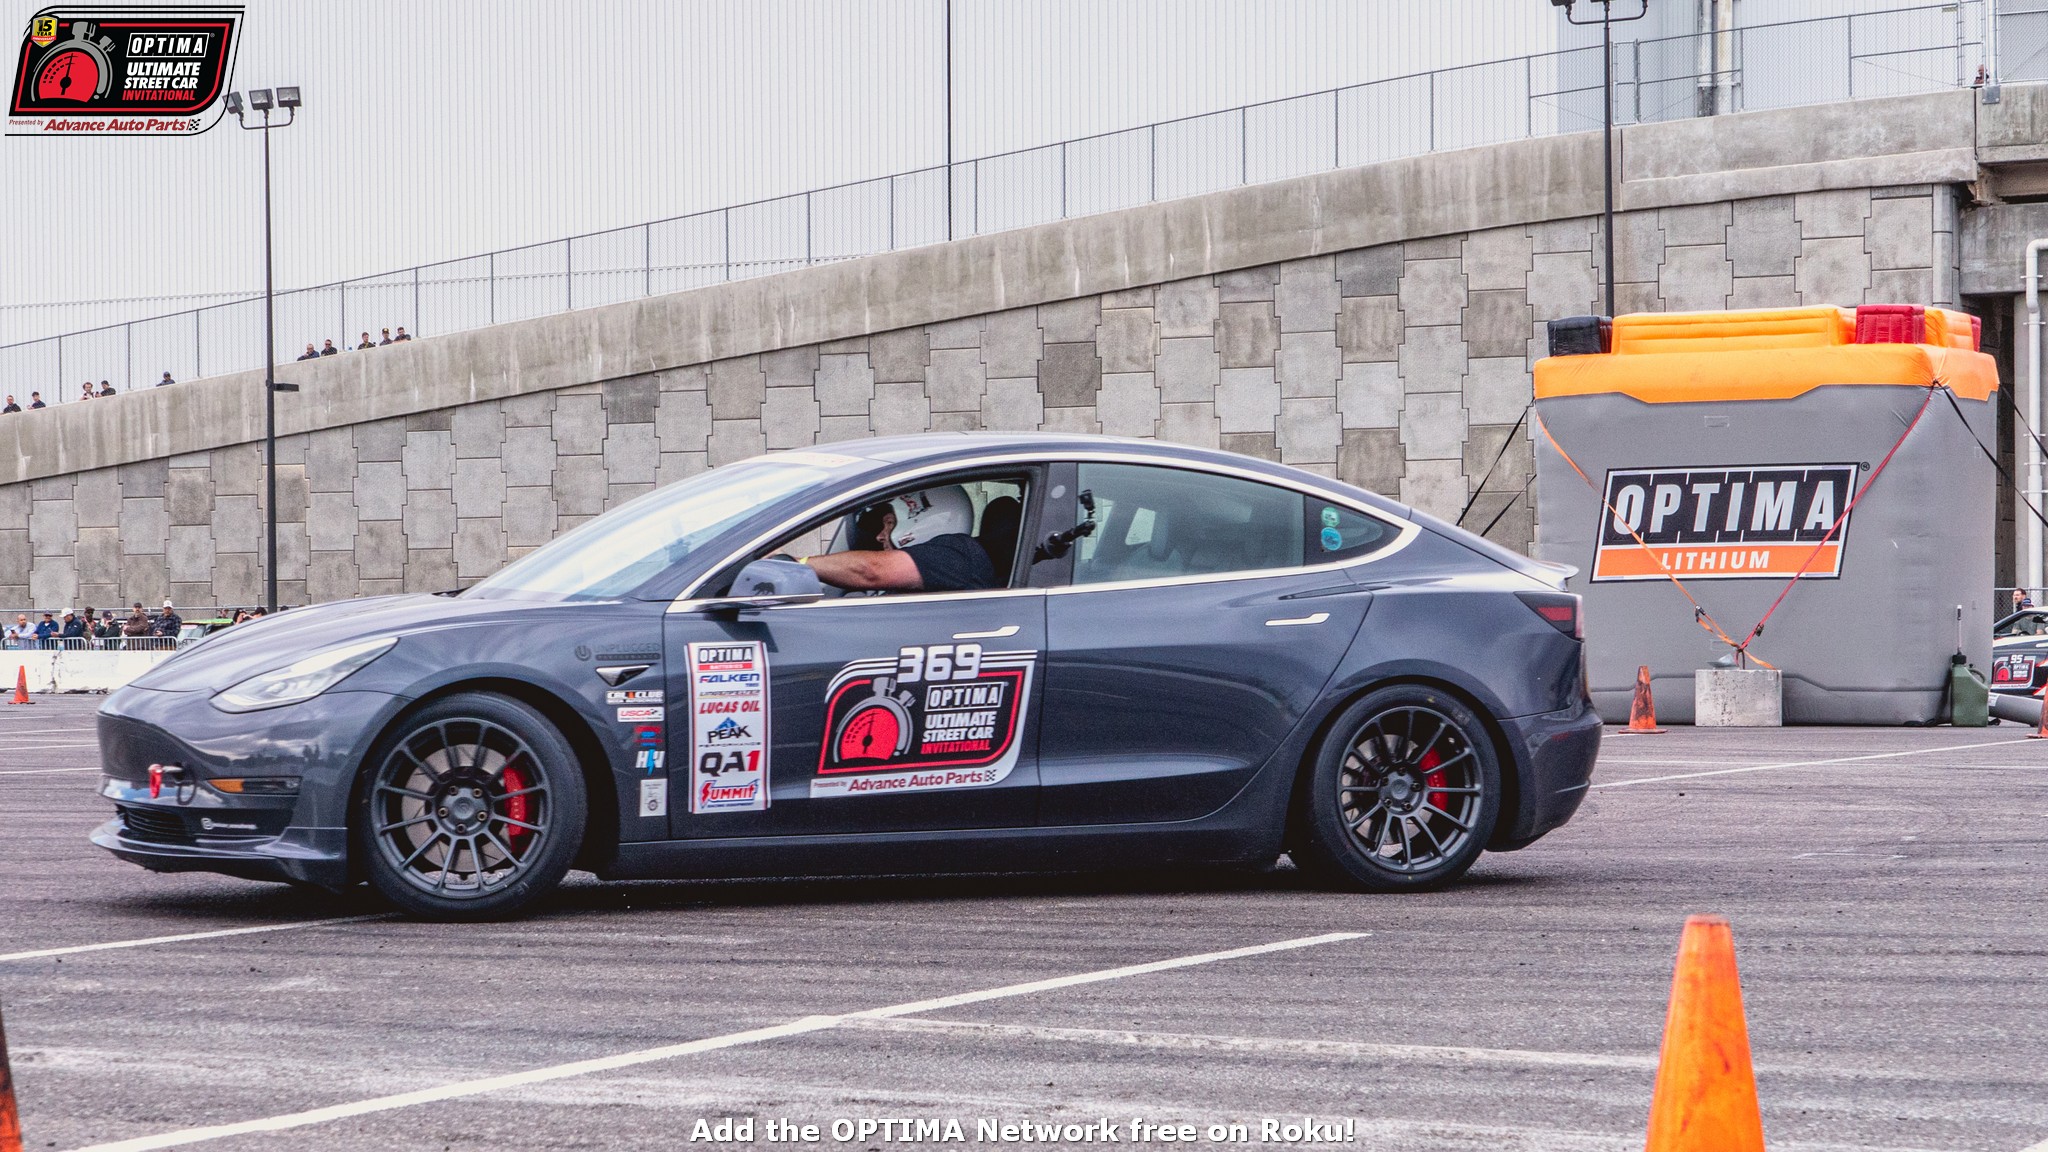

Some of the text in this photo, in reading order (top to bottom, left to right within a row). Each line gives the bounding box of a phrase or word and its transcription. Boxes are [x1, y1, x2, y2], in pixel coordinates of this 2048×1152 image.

[1613, 480, 1836, 536] OPTIMA
[1661, 550, 1770, 571] LITHIUM
[700, 648, 753, 662] OPTIMA
[897, 644, 982, 683] 369
[2010, 654, 2023, 663] 95
[699, 673, 760, 683] FALKEN
[929, 685, 999, 708] OPTIMA
[699, 700, 760, 714] LUCAS OIL
[925, 711, 998, 729] ULTIMATE
[707, 725, 752, 743] PEAK
[922, 726, 994, 743] STREET CAR
[920, 740, 992, 754] INVITATIONAL
[699, 750, 760, 777] QA1
[848, 778, 906, 792] Advance
[908, 773, 944, 788] Auto
[945, 770, 983, 785] Parts
